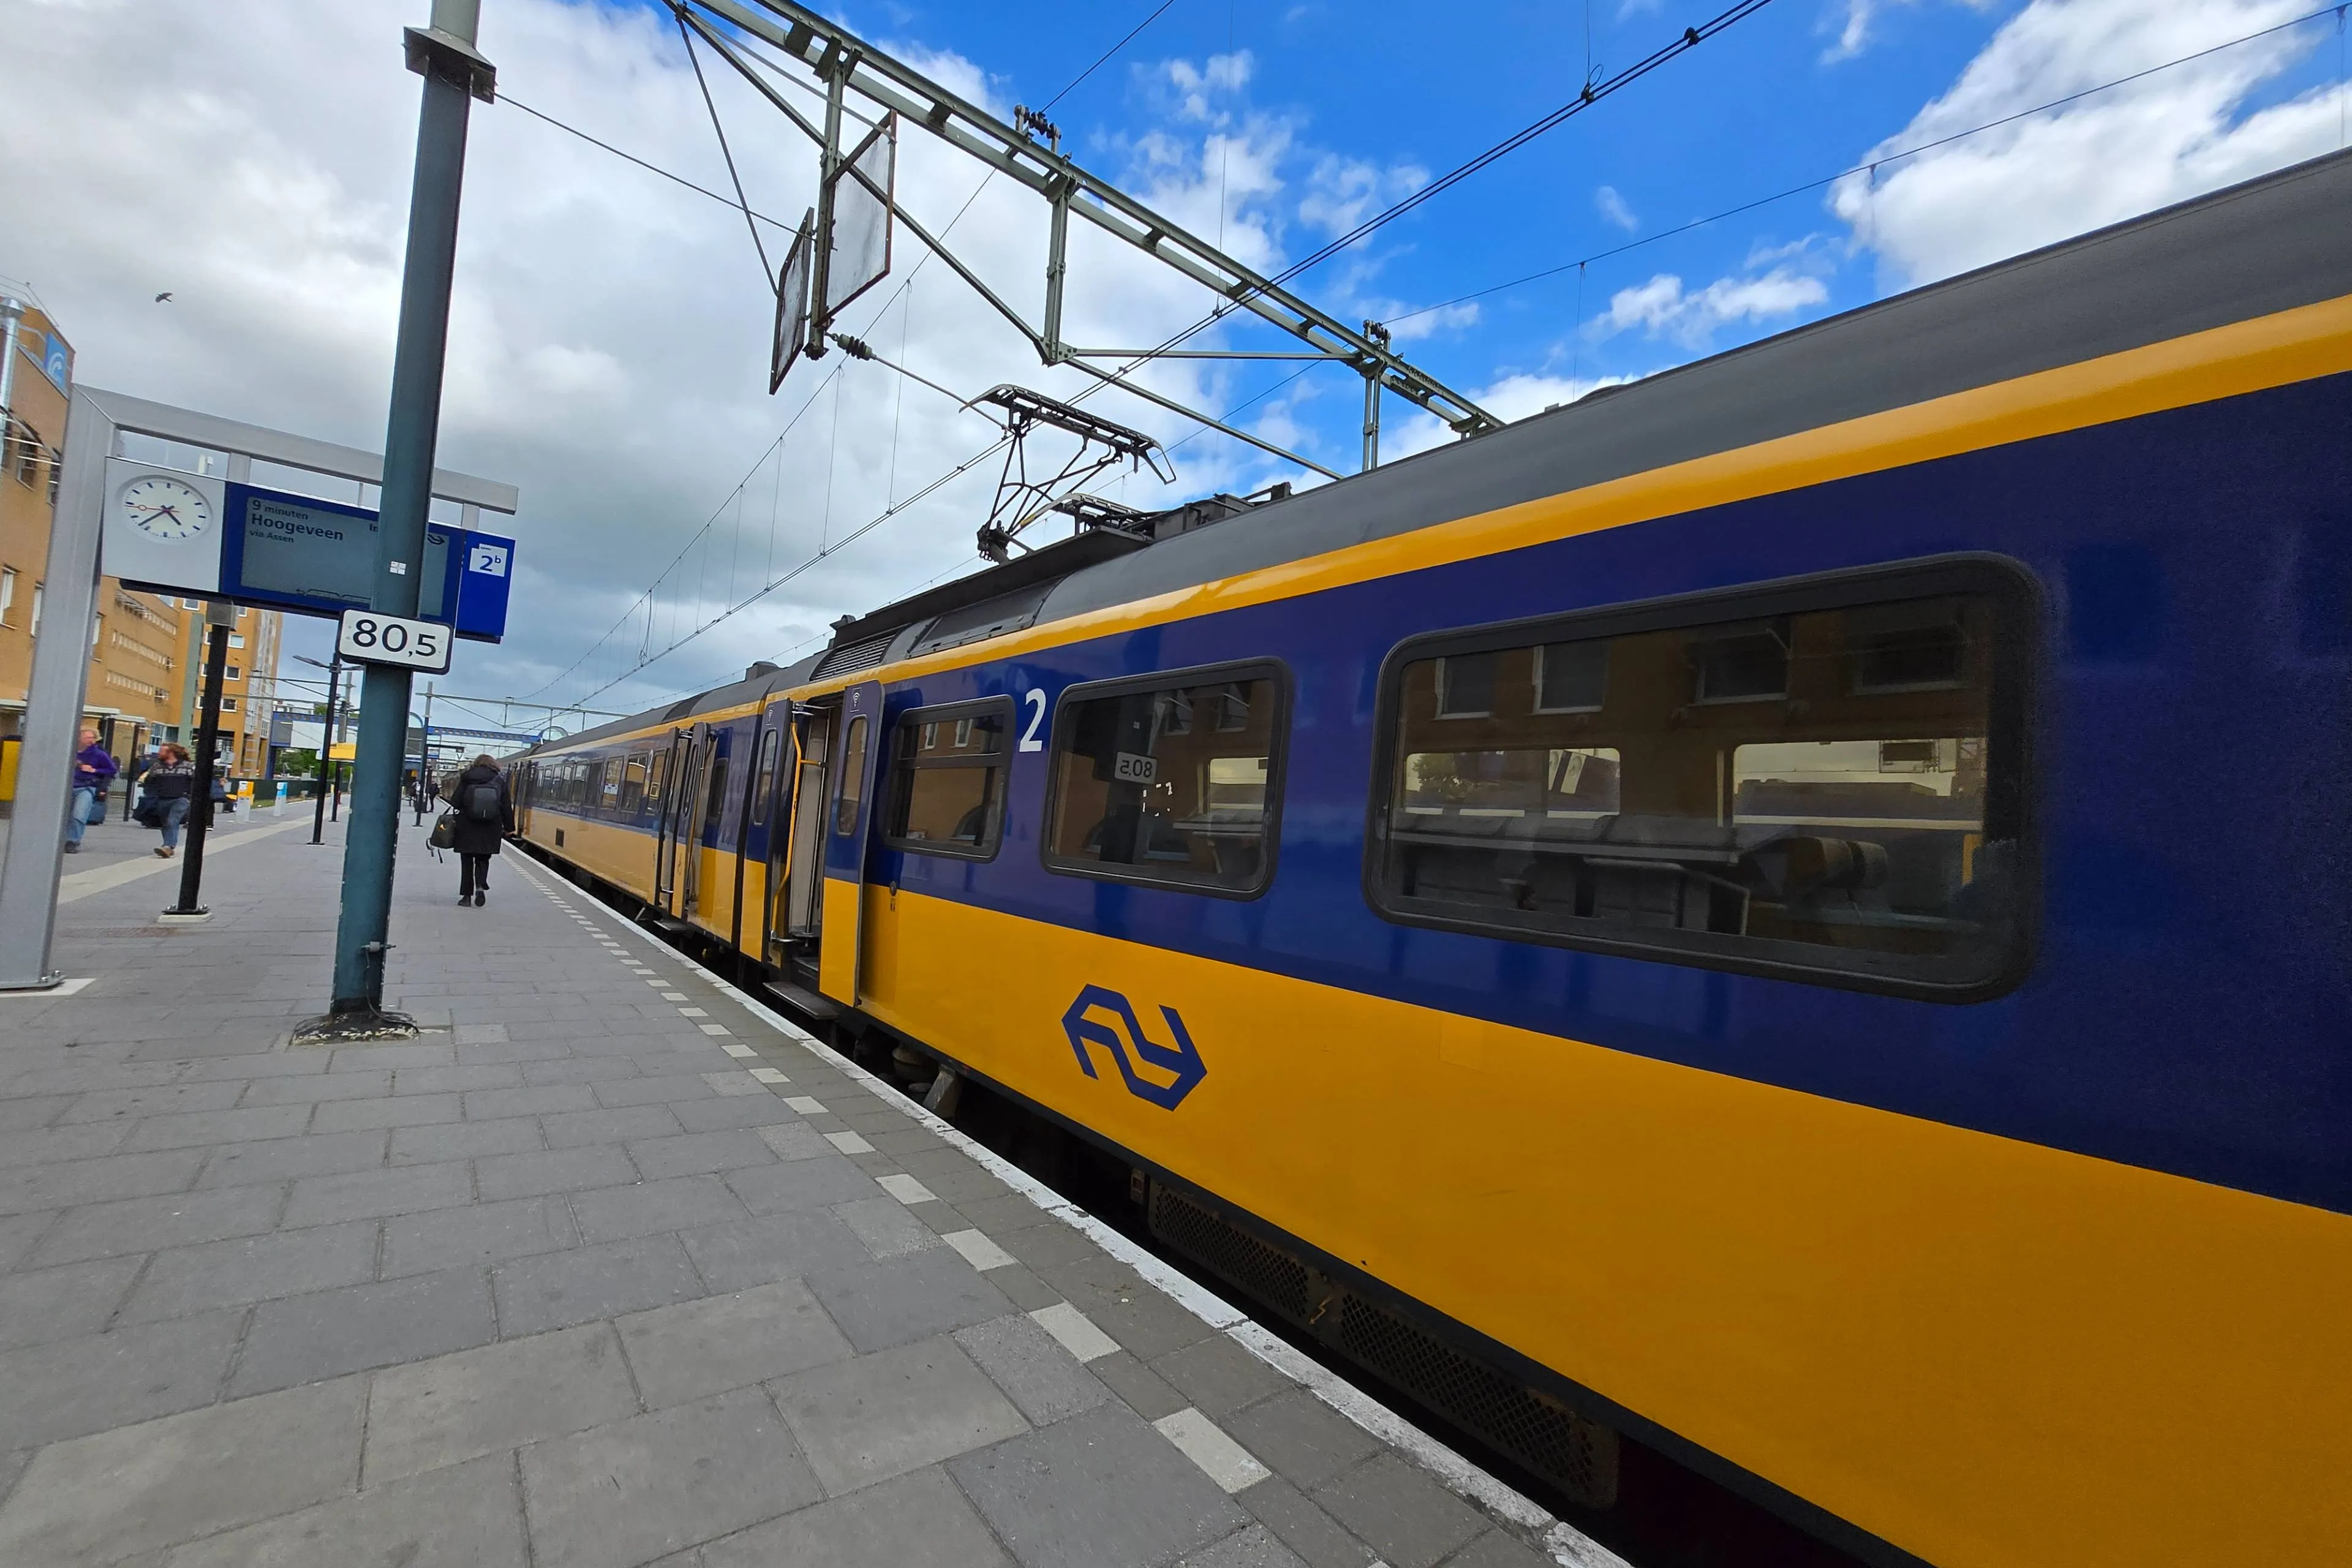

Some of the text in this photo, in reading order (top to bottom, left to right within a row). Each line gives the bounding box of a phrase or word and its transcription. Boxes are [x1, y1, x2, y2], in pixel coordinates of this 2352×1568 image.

[252, 500, 309, 520] 9 minuten
[251, 513, 344, 540] Hoogeveen
[266, 532, 294, 543] Assen
[353, 619, 436, 657] 80,5
[1019, 688, 1046, 752] 2
